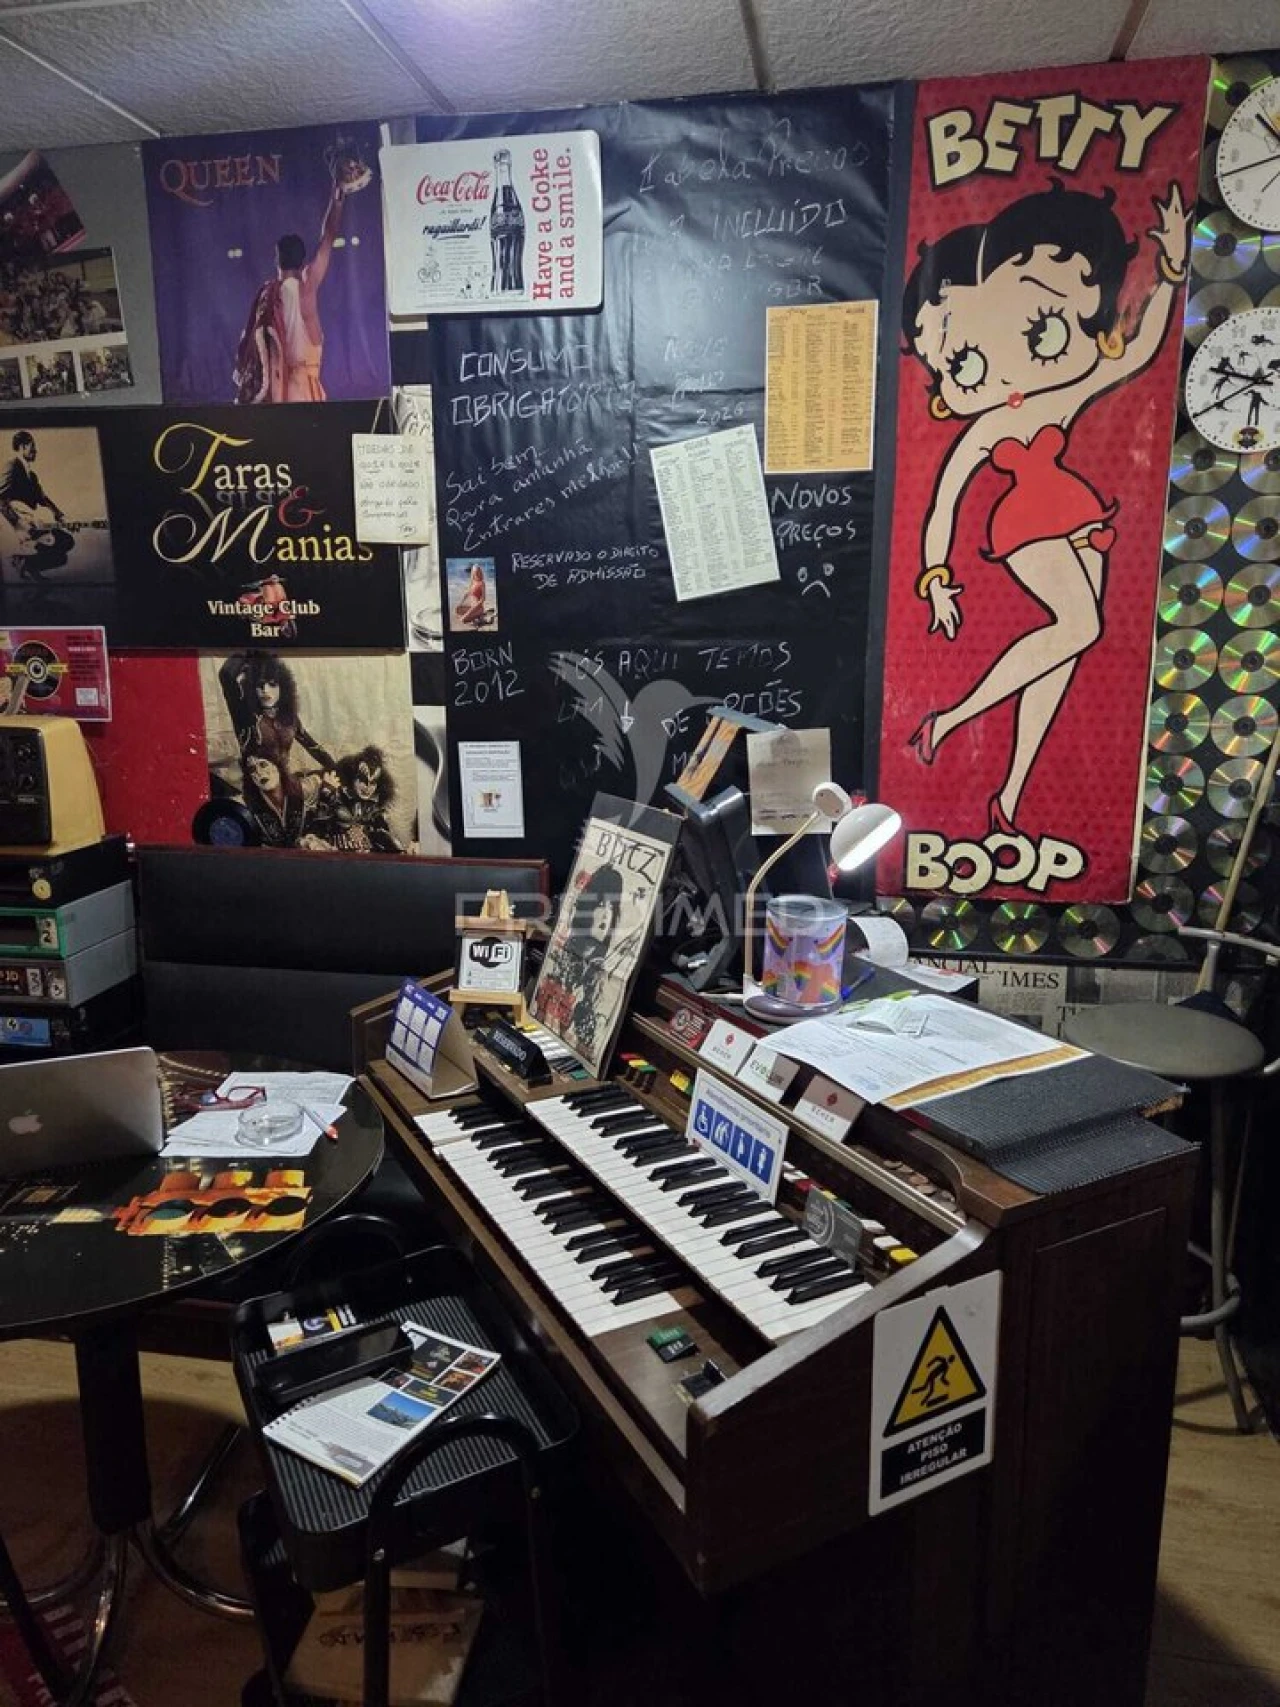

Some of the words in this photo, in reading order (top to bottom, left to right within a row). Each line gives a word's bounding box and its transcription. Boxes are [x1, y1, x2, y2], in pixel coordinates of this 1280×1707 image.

[926, 93, 1175, 189] BETTY
[159, 153, 283, 208] QUEEN
[416, 170, 491, 206] Coca-Cola
[529, 148, 552, 213] Coke
[552, 147, 575, 229] smile.
[538, 221, 552, 233] a
[560, 235, 574, 248] a
[532, 241, 552, 300] Have
[554, 255, 574, 298] and
[153, 422, 292, 492] Taras
[771, 481, 852, 513] NOVOS
[152, 505, 373, 564] Manias
[208, 600, 274, 616] Vintage
[278, 600, 321, 615] Club
[251, 624, 282, 637] Bar
[451, 642, 514, 676] BORN
[454, 670, 525, 706] 2012
[904, 831, 1086, 895] BOOP
[907, 1423, 963, 1454] ATENÇÃO
[920, 1443, 948, 1462] PISO
[899, 1448, 967, 1485] IRREGULAR
